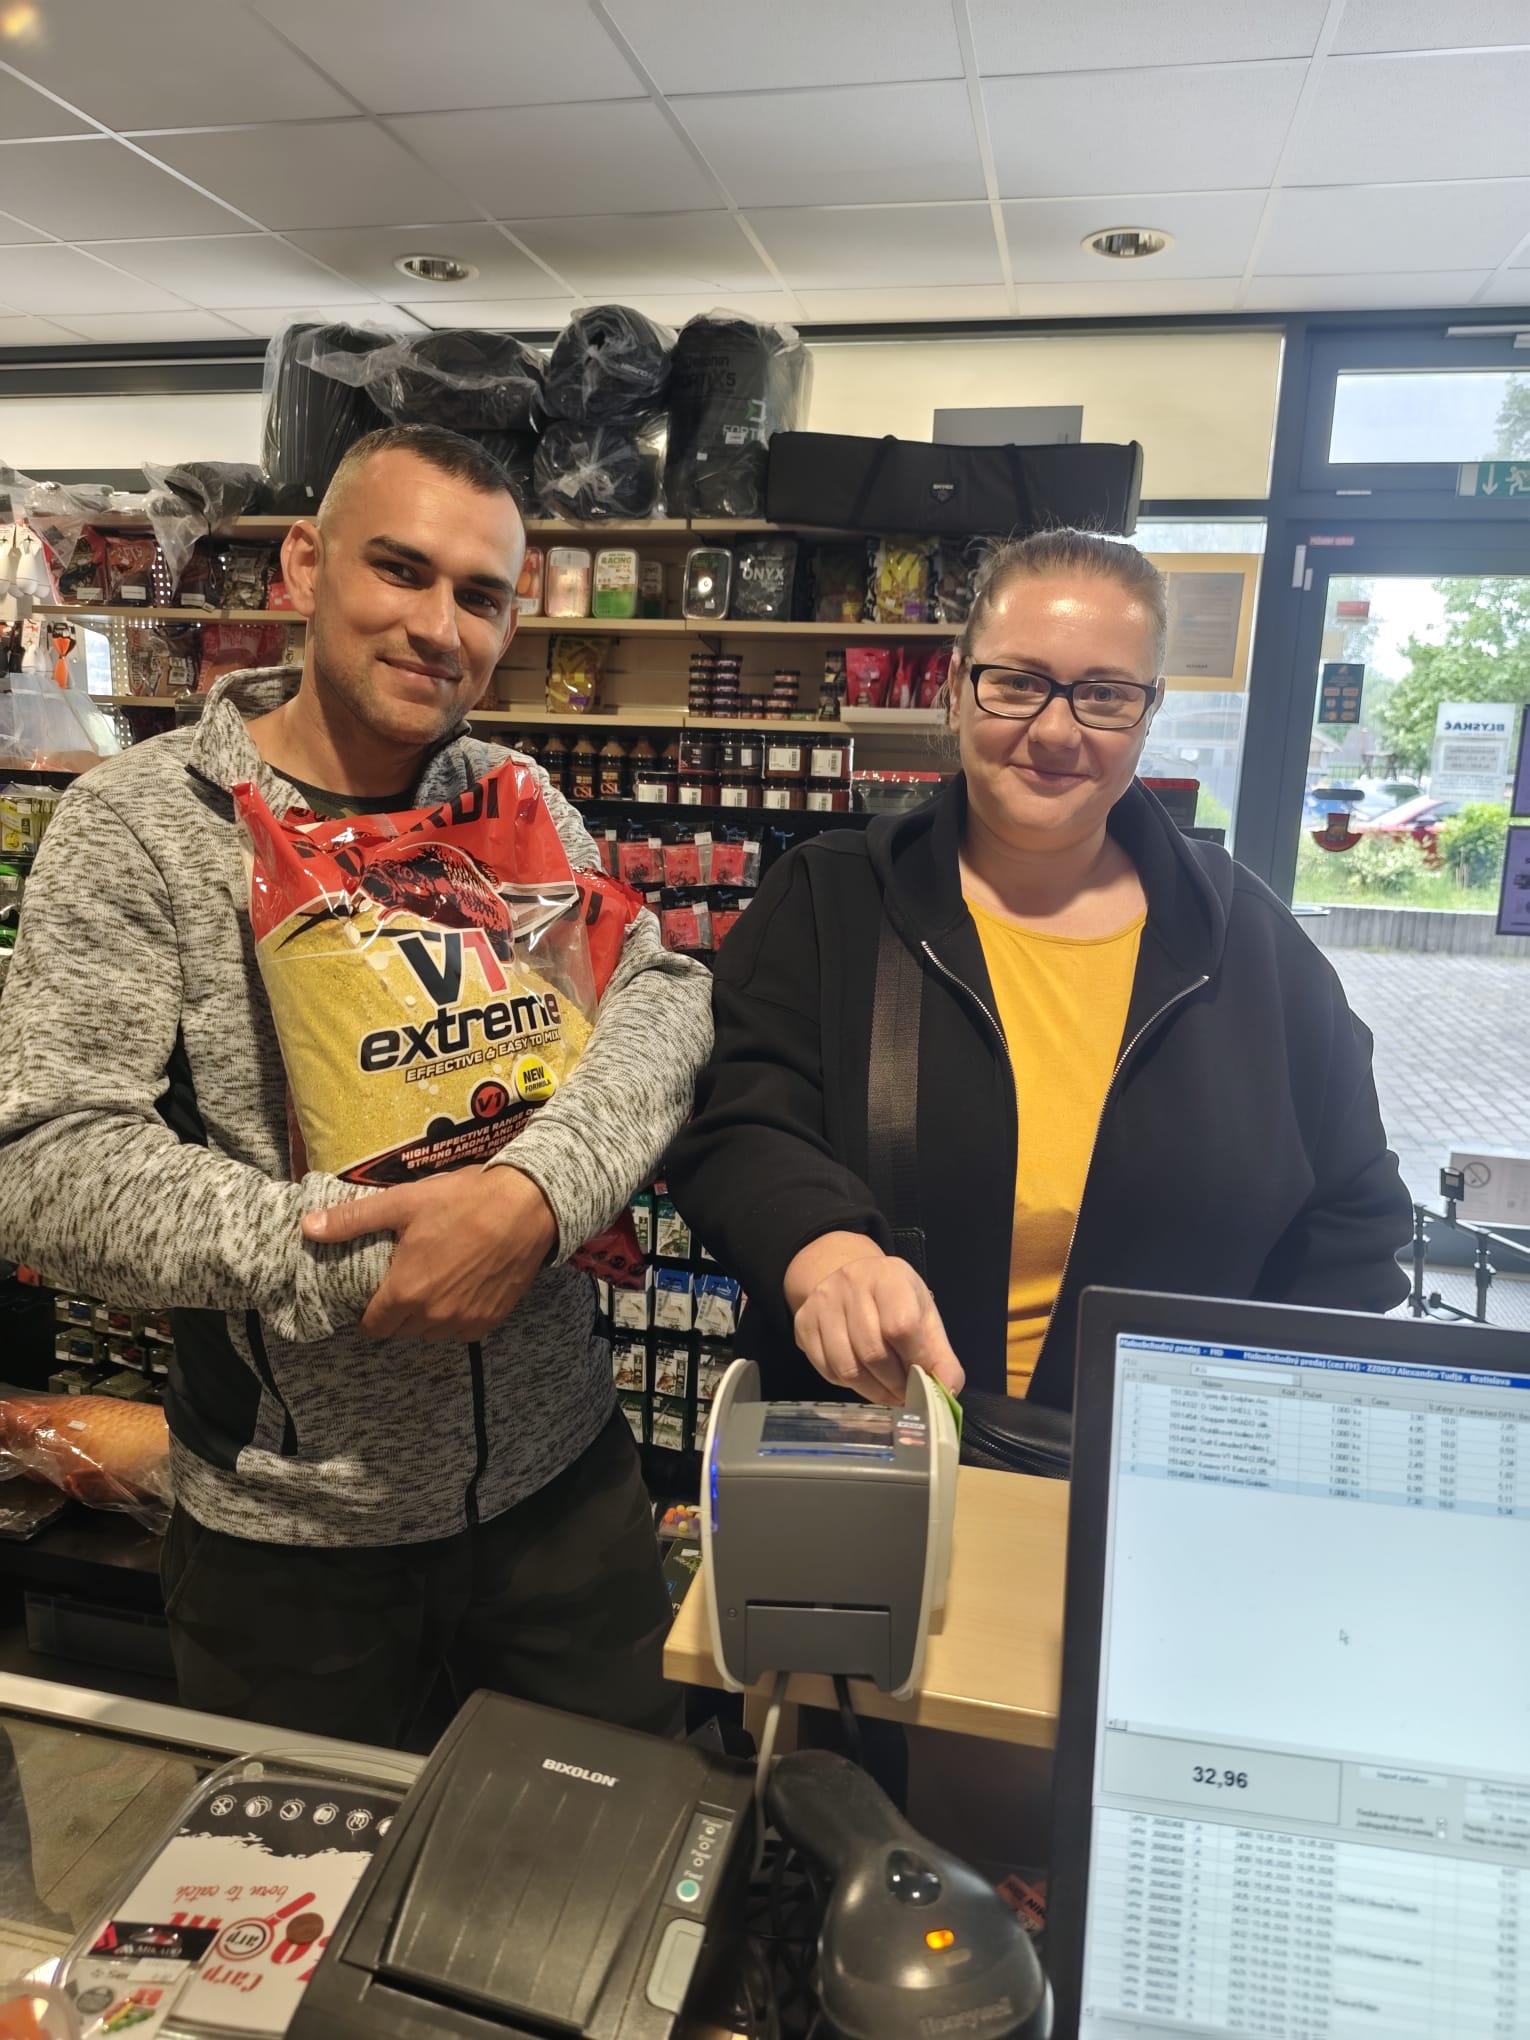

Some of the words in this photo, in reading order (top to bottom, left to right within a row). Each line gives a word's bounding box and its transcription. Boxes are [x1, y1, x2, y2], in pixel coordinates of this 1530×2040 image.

[742, 567, 785, 581] ONYX
[573, 785, 594, 798] CSL
[601, 782, 621, 794] CSL
[395, 928, 509, 1007] V1
[359, 992, 562, 1073] extreme
[405, 1051, 484, 1083] EFFECTIVE
[486, 1045, 497, 1060] &
[498, 1037, 529, 1056] EASY
[529, 1033, 544, 1047] TO
[523, 1065, 546, 1085] NEW
[524, 1077, 552, 1094] FORMULA
[478, 1090, 505, 1113] V1
[401, 1146, 431, 1162] HIGH
[431, 1125, 491, 1152] EFFECTIVE
[491, 1112, 524, 1132] RANGE
[406, 1149, 452, 1169] STRONG
[454, 1134, 491, 1155] AROMA
[492, 1125, 514, 1139] AND
[487, 1128, 524, 1153] PERFEC
[1397, 1367, 1439, 1380] Alexander
[1469, 1375, 1511, 1387] Bratislava
[542, 1758, 617, 1788] BIXOLON
[1192, 1765, 1249, 1789] 32,96
[174, 1884, 221, 1904] catch
[224, 1885, 245, 1903] to
[249, 1885, 289, 1903] born
[202, 1964, 263, 1993] Carp
